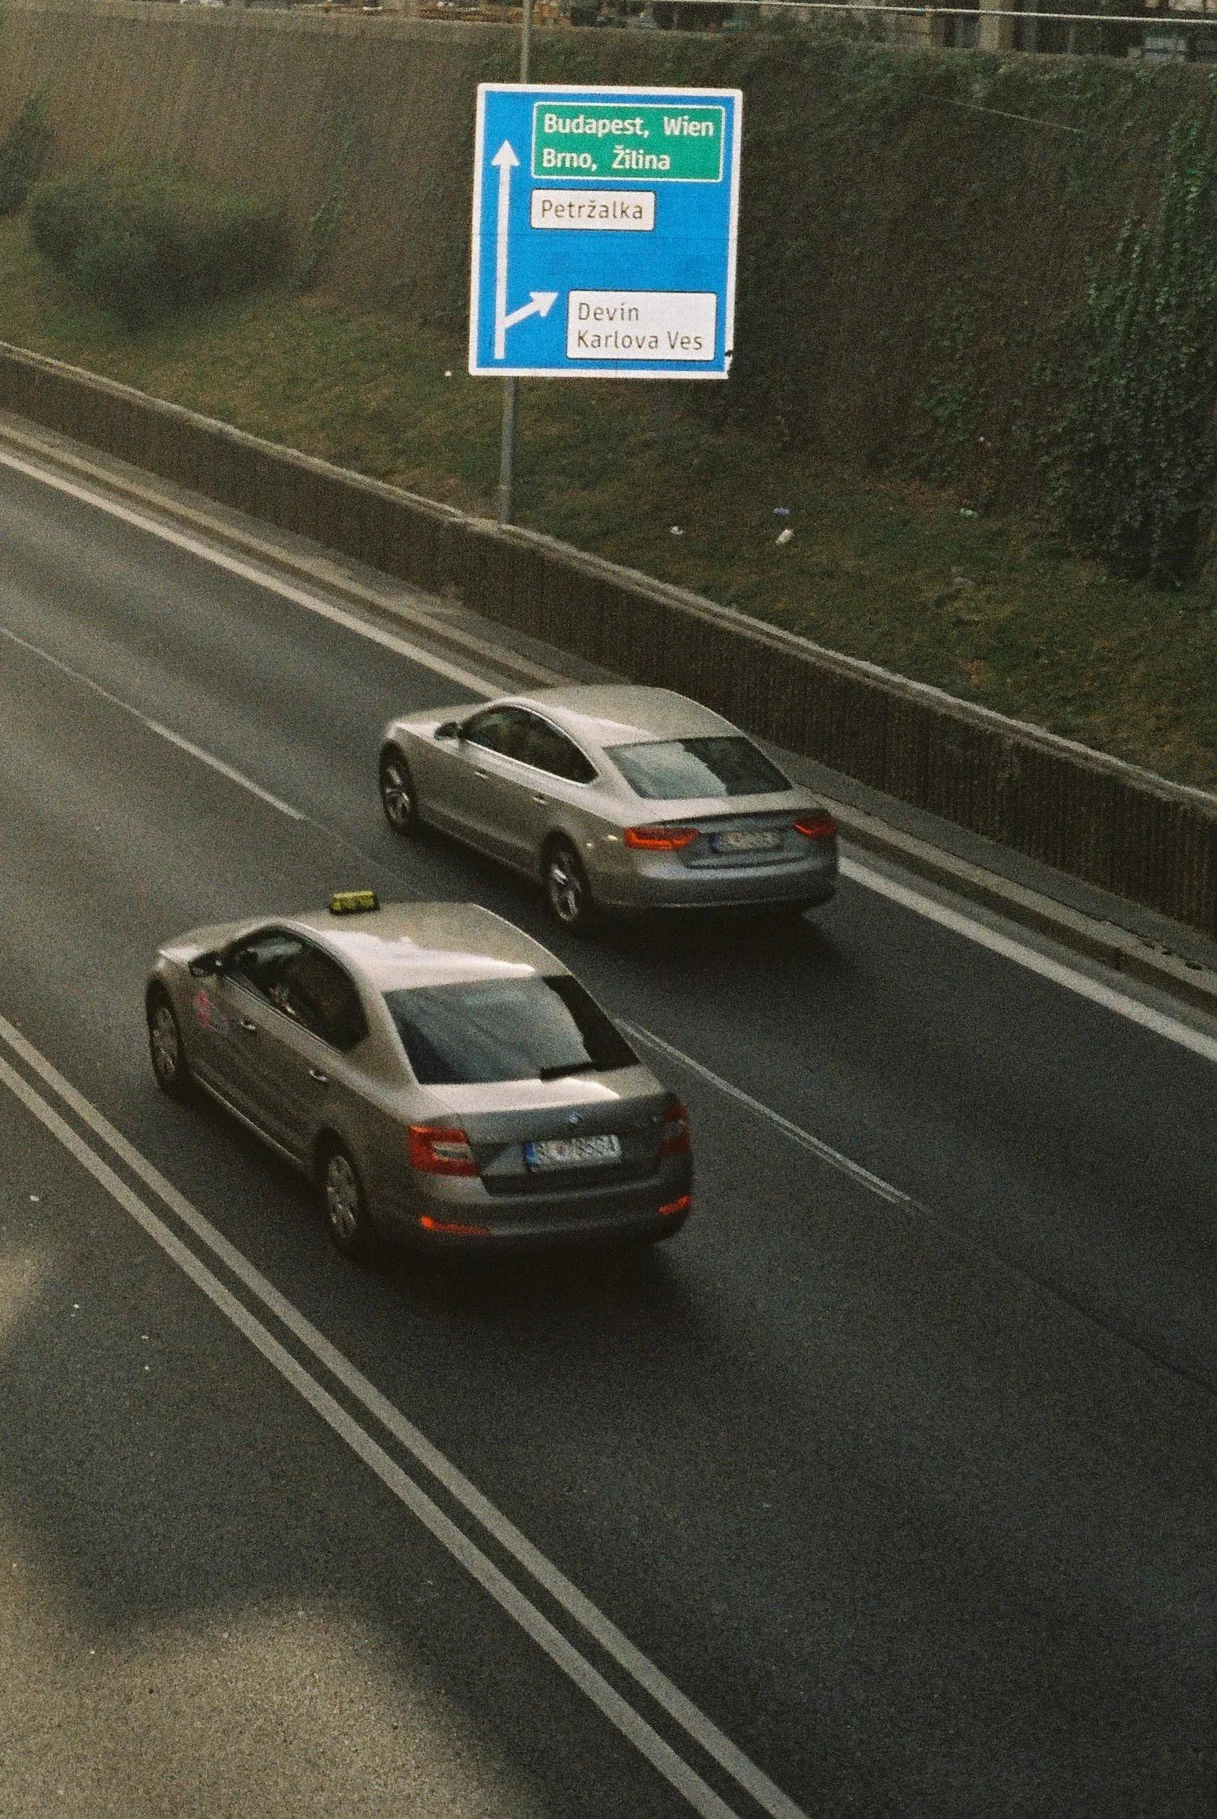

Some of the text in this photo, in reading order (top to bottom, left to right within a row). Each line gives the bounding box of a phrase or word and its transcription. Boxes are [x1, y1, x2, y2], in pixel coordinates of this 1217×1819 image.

[544, 113, 714, 138] Budapest, Wien
[542, 145, 671, 171] Brno, Žilina
[541, 199, 644, 219] Petržalka
[578, 302, 639, 321] Devín
[577, 330, 703, 350] Karlova Ves
